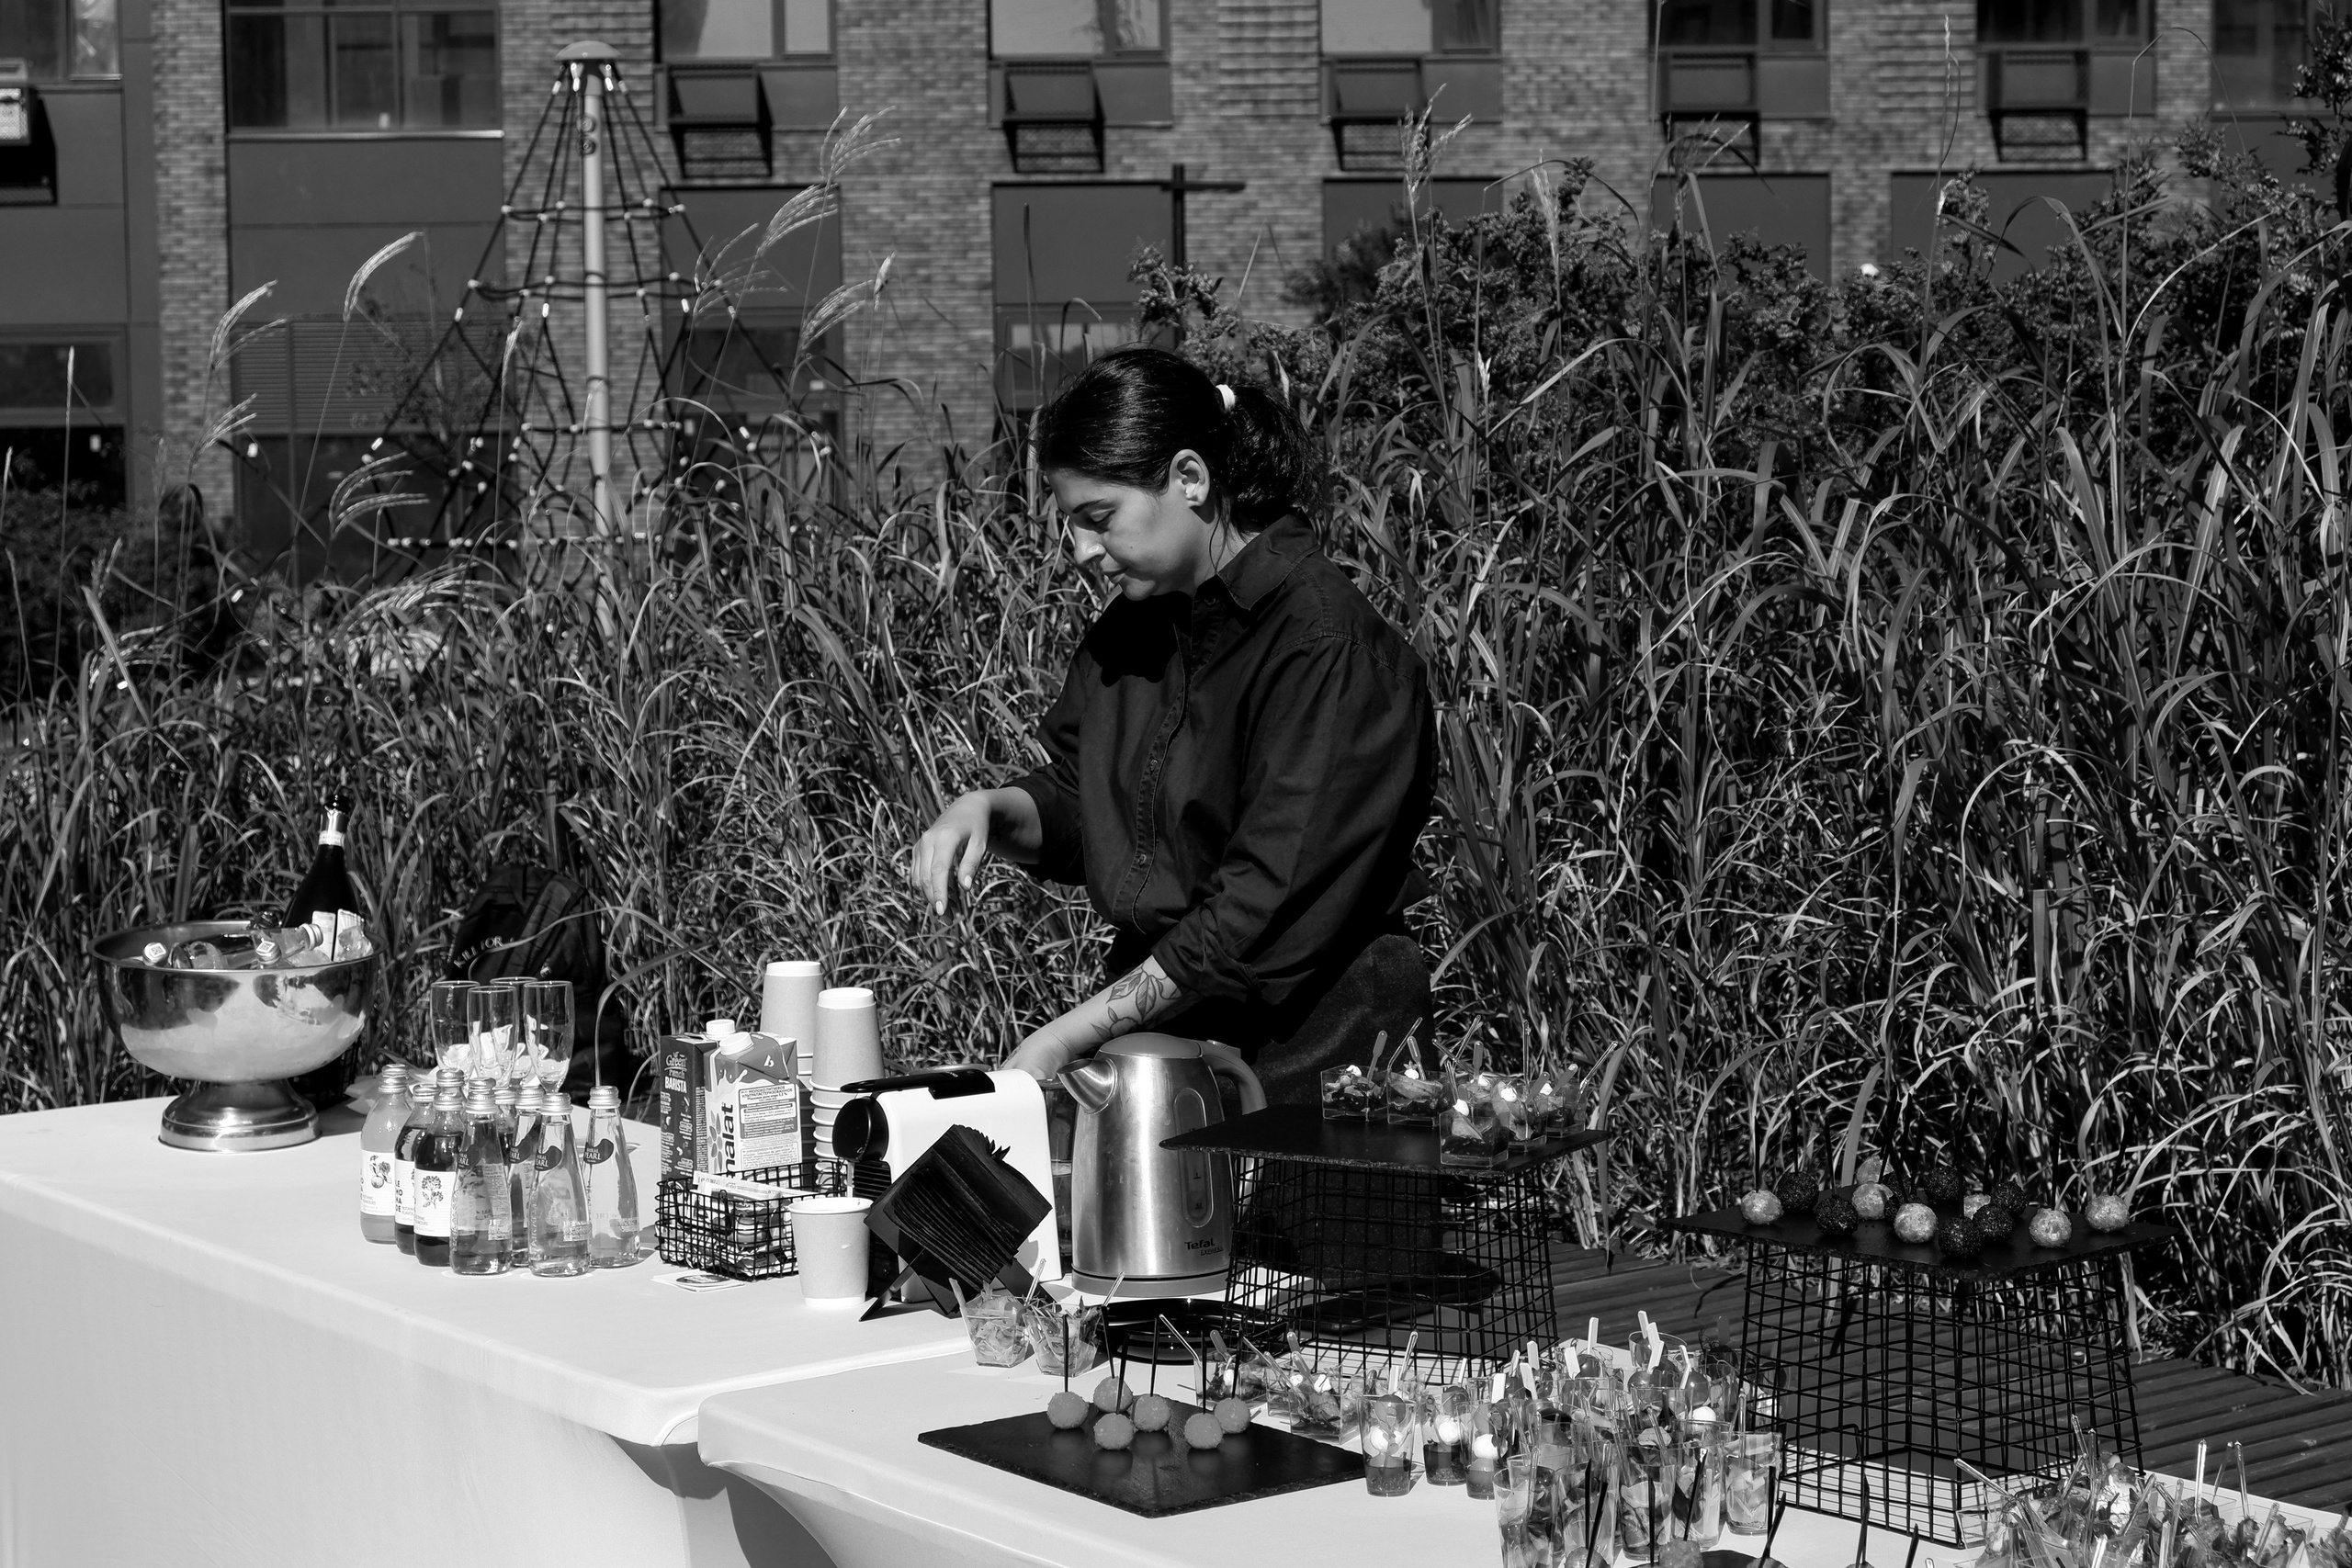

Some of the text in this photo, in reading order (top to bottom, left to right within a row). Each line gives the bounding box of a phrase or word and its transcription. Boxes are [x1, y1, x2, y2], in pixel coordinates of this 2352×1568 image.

[665, 1054, 686, 1066] Green
[664, 1075, 687, 1093] BARISTA
[1184, 1237, 1216, 1250] Tefal
